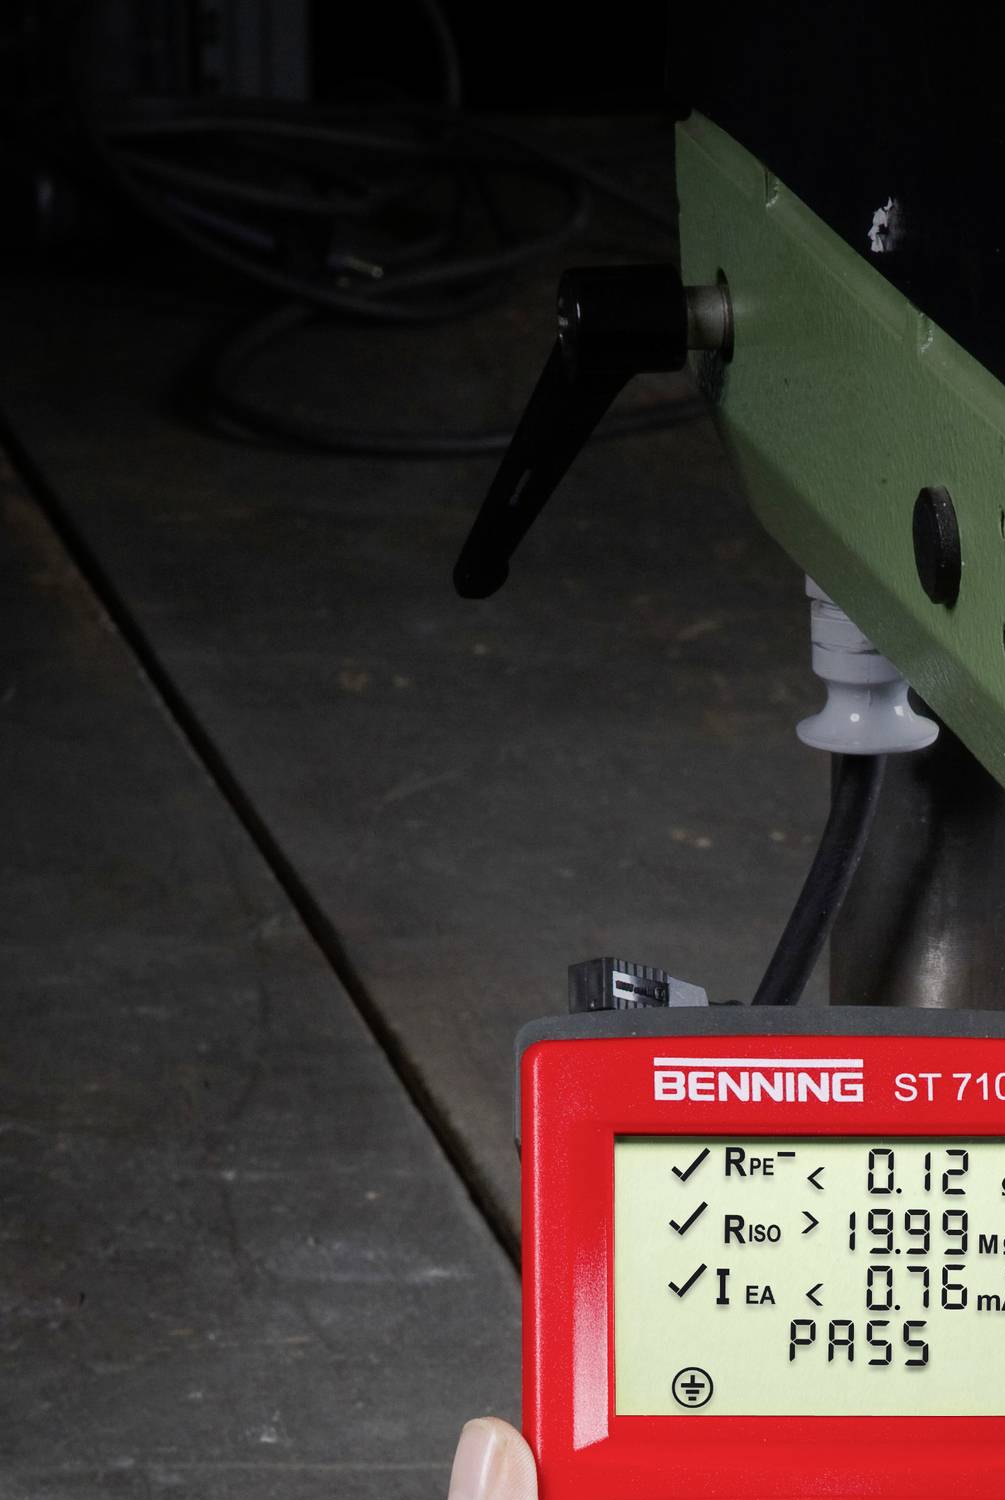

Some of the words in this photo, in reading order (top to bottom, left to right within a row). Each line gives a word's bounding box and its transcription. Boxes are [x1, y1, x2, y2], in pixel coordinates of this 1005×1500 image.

[654, 1071, 863, 1102] BENNING
[895, 1073, 941, 1101] ST
[868, 1149, 968, 1195] 0.12
[725, 1215, 781, 1244] RISO
[850, 1209, 968, 1255] 19.99
[867, 1265, 967, 1311] 0.76
[790, 1319, 928, 1366] PASS
